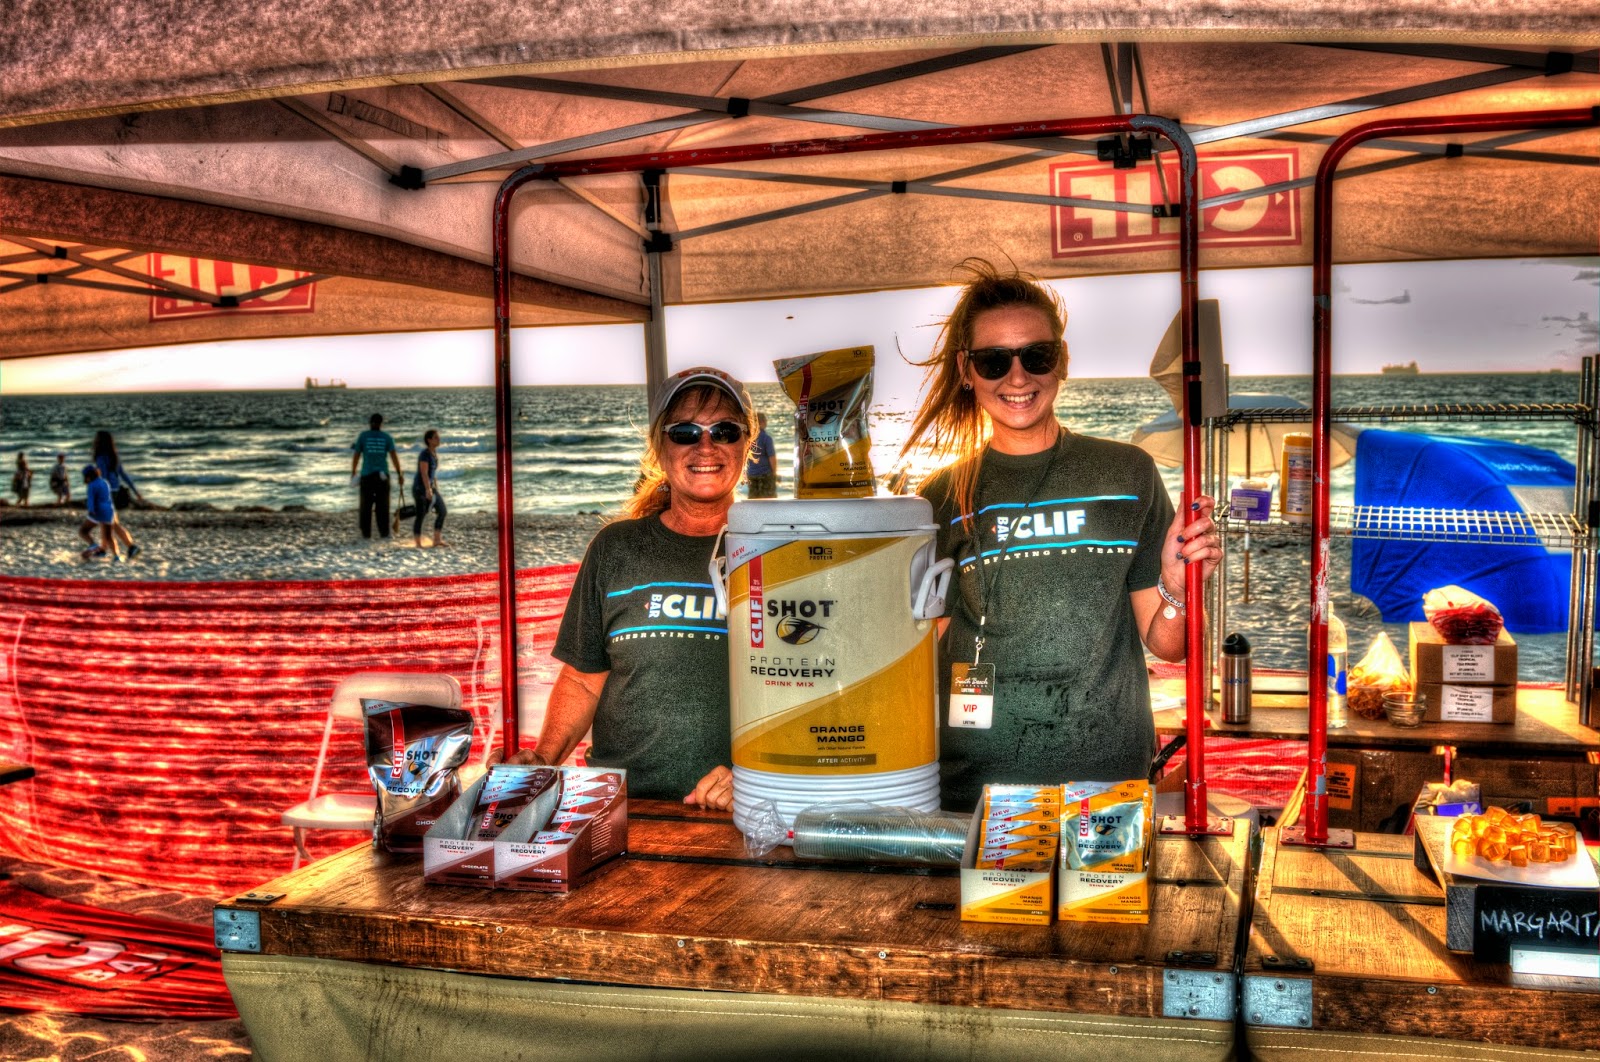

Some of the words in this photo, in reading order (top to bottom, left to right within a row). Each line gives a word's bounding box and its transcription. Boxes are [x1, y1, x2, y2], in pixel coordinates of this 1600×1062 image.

[809, 400, 845, 411] SHOT
[1011, 509, 1086, 539] CLIF
[731, 545, 745, 559] NEW
[808, 546, 833, 555] 10G
[648, 594, 663, 618] BAR
[767, 599, 834, 617] SHOT
[751, 600, 763, 645] CLIF
[749, 655, 835, 666] PROTEIN
[750, 666, 835, 678] RECOVERY
[963, 704, 977, 712] VIP
[809, 725, 865, 733] ORANGE
[817, 735, 865, 743] MANGO
[406, 750, 438, 760] SHOT
[393, 750, 404, 775] CLIF
[1068, 789, 1086, 797] NEW
[992, 809, 1010, 817] NEW
[989, 823, 1006, 832] NEW
[1080, 814, 1088, 835] CLIF
[988, 836, 1005, 844] NEW
[985, 851, 1003, 859] NEW
